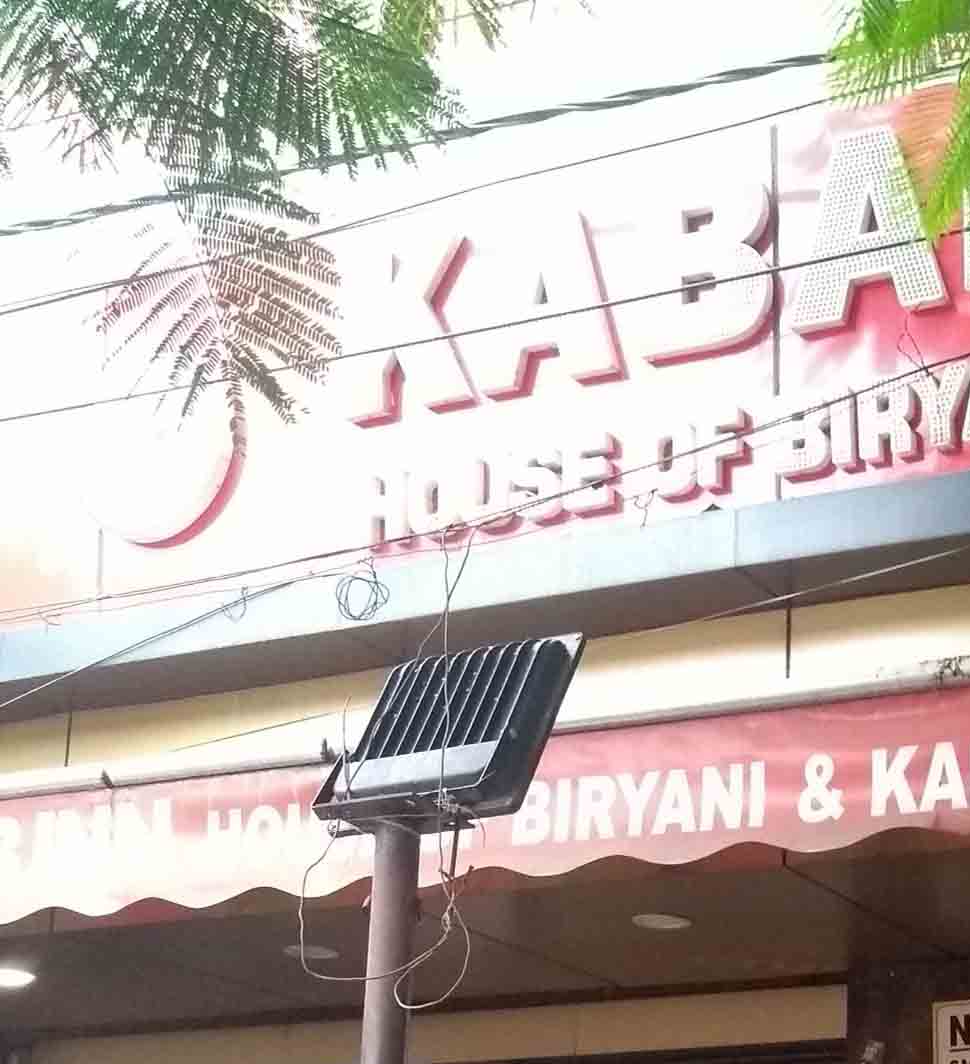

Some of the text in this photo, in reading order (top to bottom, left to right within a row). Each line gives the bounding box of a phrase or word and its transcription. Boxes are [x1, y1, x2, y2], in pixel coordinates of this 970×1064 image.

[655, 408, 753, 503] OF
[511, 760, 766, 846] BIRYANI
[798, 753, 843, 822] &
